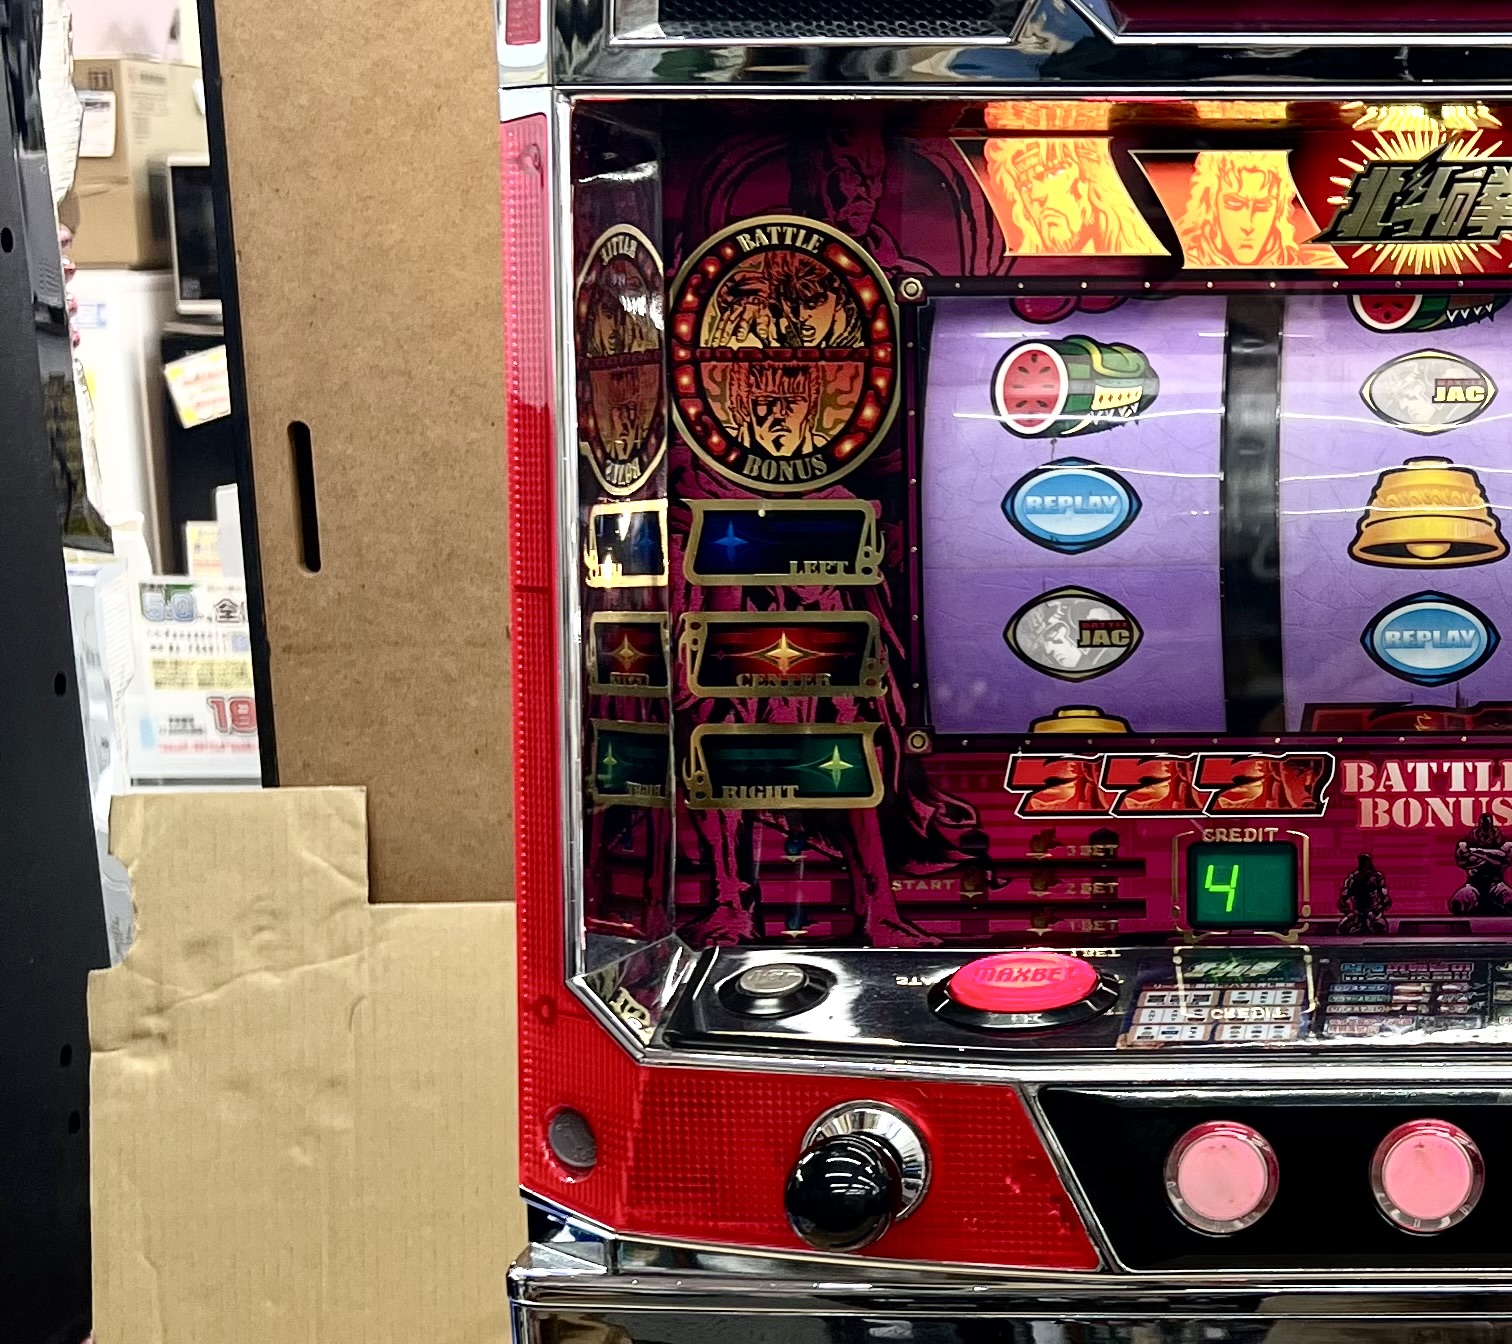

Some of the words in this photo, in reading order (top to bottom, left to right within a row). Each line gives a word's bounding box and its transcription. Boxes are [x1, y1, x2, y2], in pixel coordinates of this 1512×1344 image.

[735, 225, 825, 254] BATTLE
[1433, 384, 1486, 403] JAC
[742, 453, 828, 482] BONUS
[1025, 494, 1118, 515] REPLAY
[788, 560, 849, 575] LEFT
[1080, 629, 1130, 646] JAC
[1384, 629, 1477, 648] REPLAY
[735, 673, 832, 687] CENTER
[721, 784, 800, 799] RIGHT
[1202, 827, 1280, 843] CREDIT
[1080, 844, 1119, 856] BET
[891, 879, 956, 892] START
[1080, 882, 1119, 895] BET
[1204, 864, 1240, 913] 4
[1080, 919, 1119, 931] BET
[974, 965, 1079, 984] MAXBET
